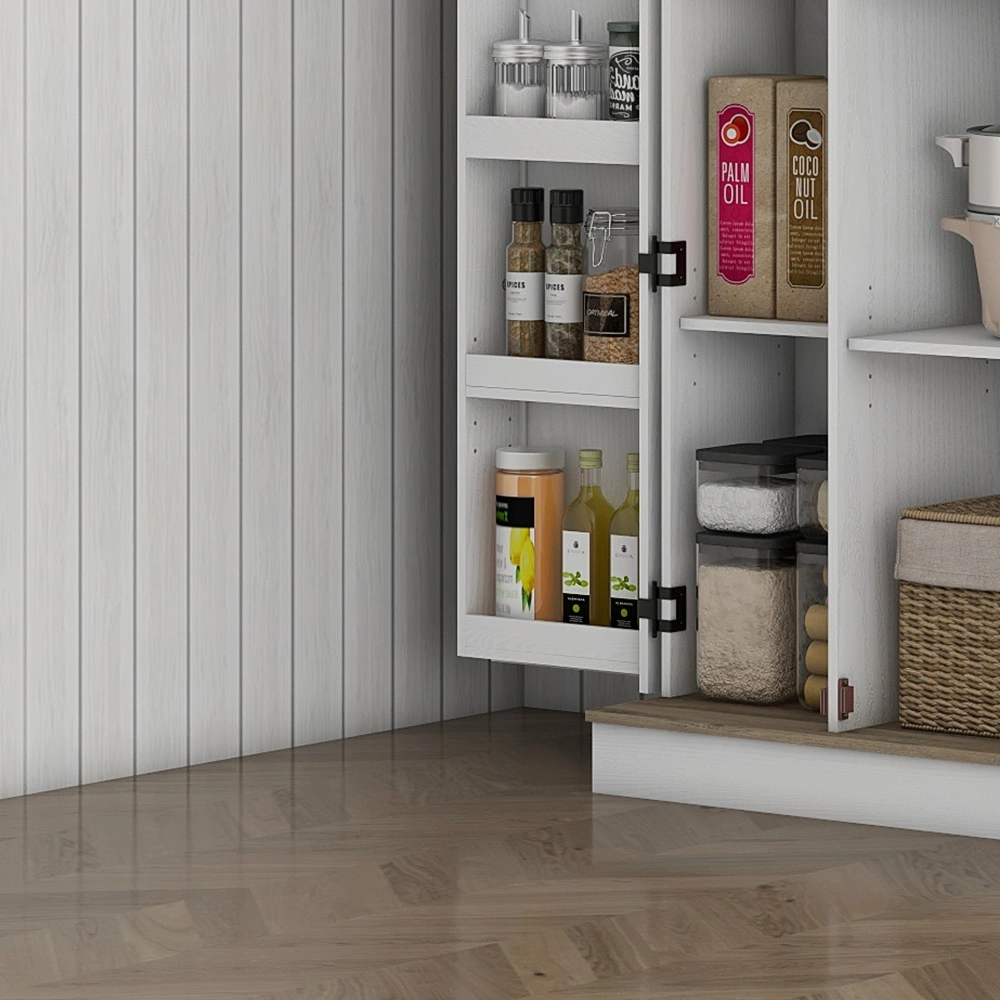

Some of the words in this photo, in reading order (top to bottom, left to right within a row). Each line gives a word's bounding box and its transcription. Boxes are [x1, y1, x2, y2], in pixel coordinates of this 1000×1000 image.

[721, 161, 750, 183] PALM
[792, 155, 819, 177] COCO
[723, 183, 749, 205] OIL
[795, 177, 816, 198] NUT
[793, 198, 819, 220] OIL
